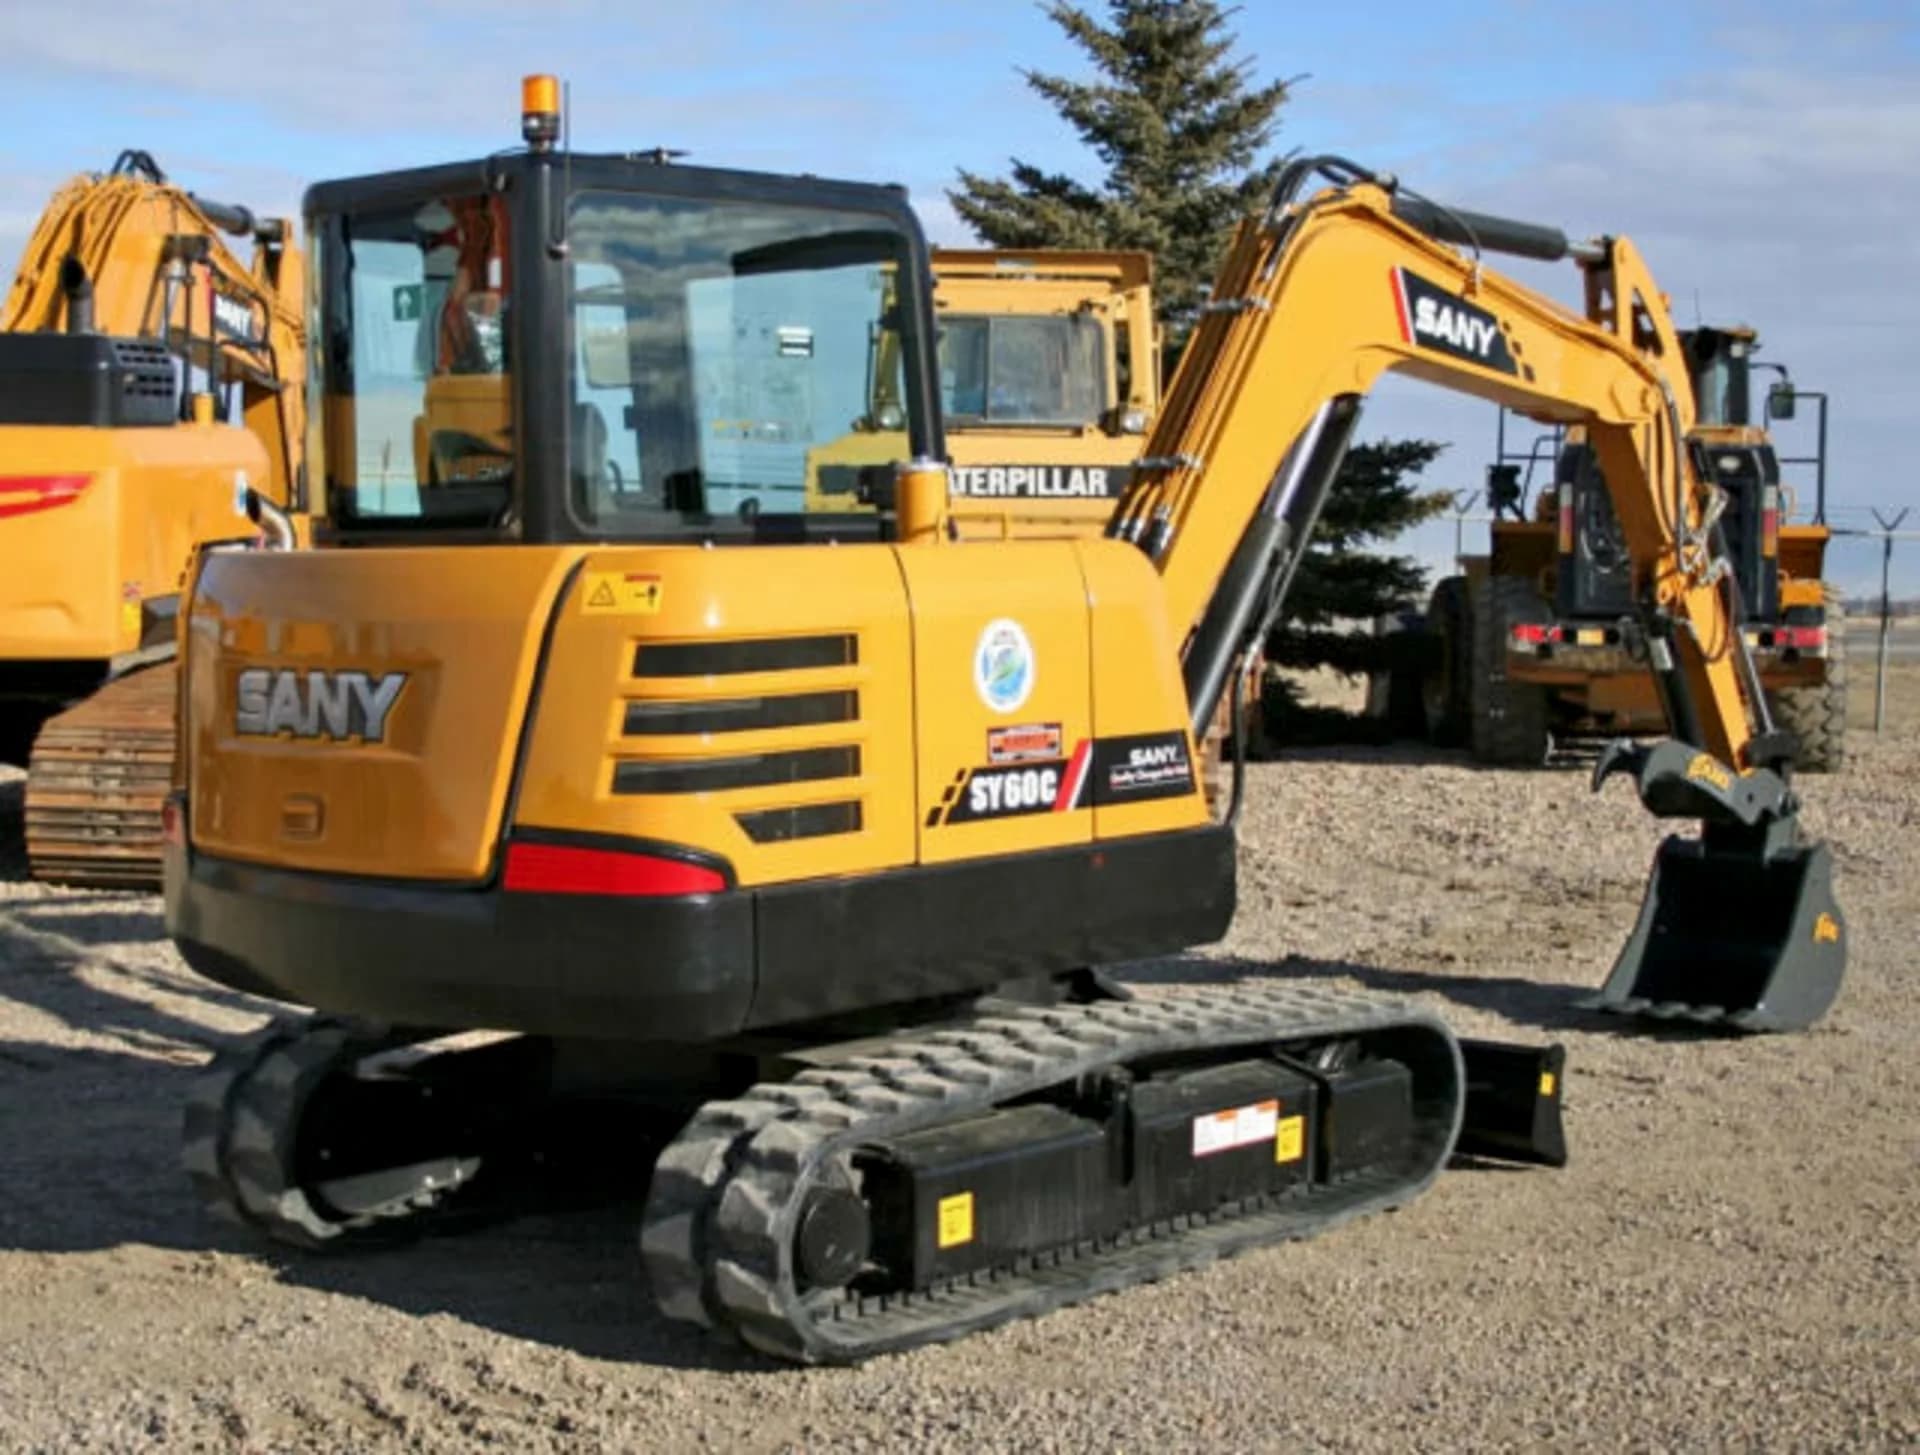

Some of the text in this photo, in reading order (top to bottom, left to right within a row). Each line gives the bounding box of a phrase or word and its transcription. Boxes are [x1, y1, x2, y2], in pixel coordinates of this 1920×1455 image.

[1415, 296, 1496, 357] SANY
[948, 466, 1108, 497] ATERPILLAR
[238, 668, 405, 742] SANY
[1129, 745, 1177, 767] SANY
[969, 768, 1058, 813] SY60C
